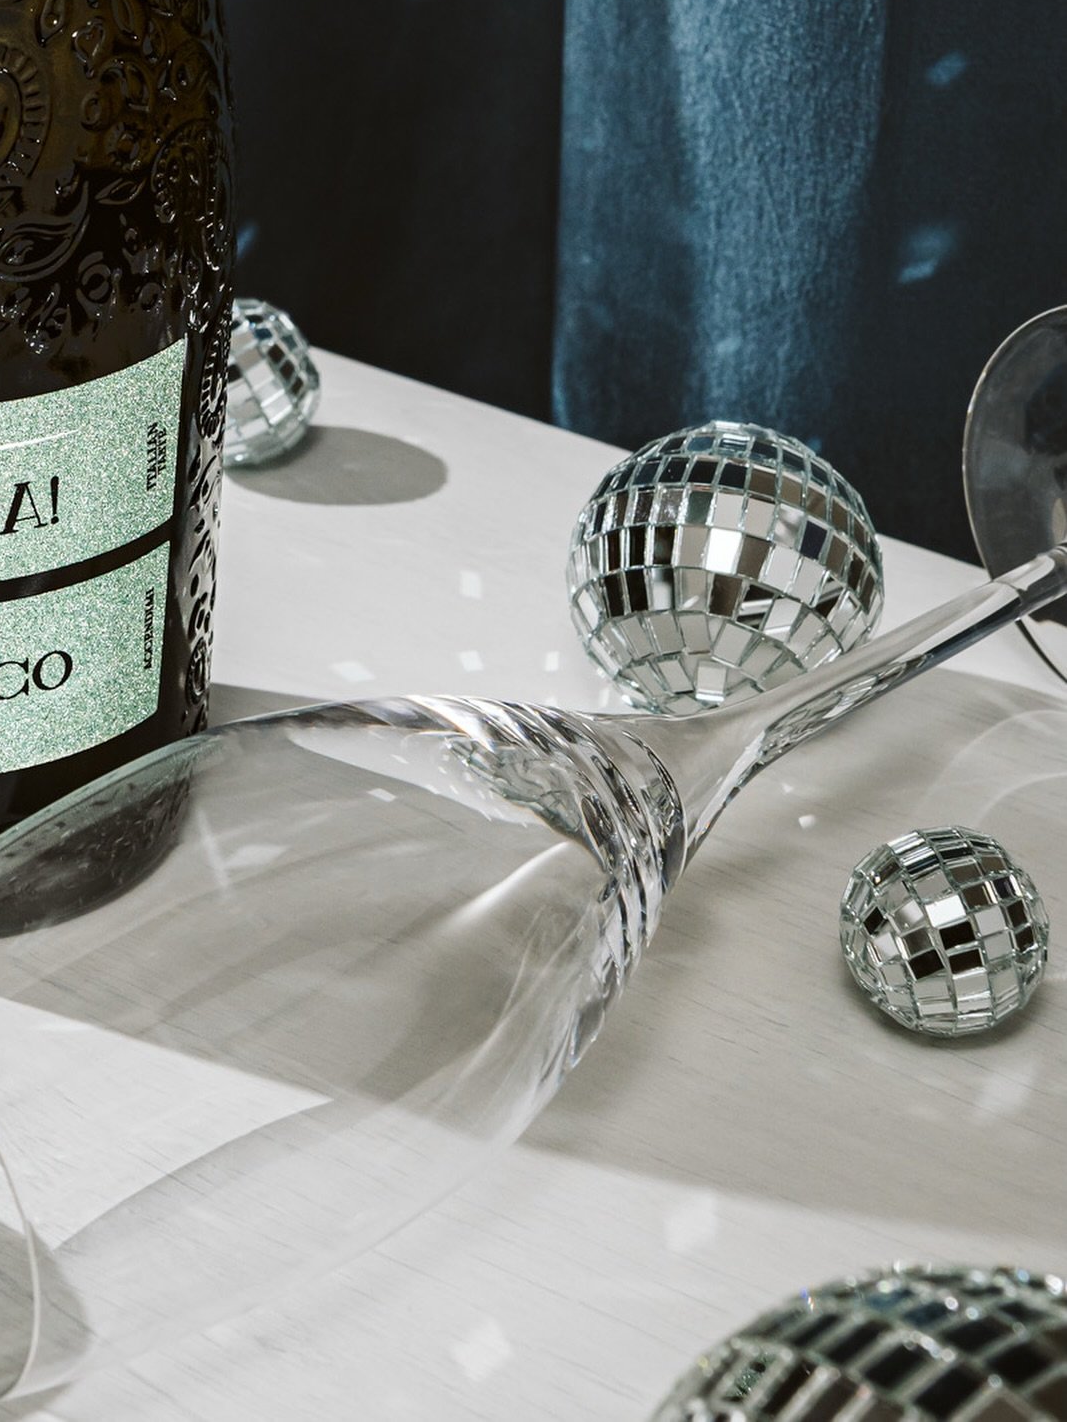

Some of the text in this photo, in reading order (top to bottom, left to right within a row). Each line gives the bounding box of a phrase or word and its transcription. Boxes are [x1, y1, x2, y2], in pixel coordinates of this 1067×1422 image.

[146, 421, 158, 492] ITALIAN
[157, 427, 167, 475] TASTE
[143, 586, 155, 670] ACCENDIMI
